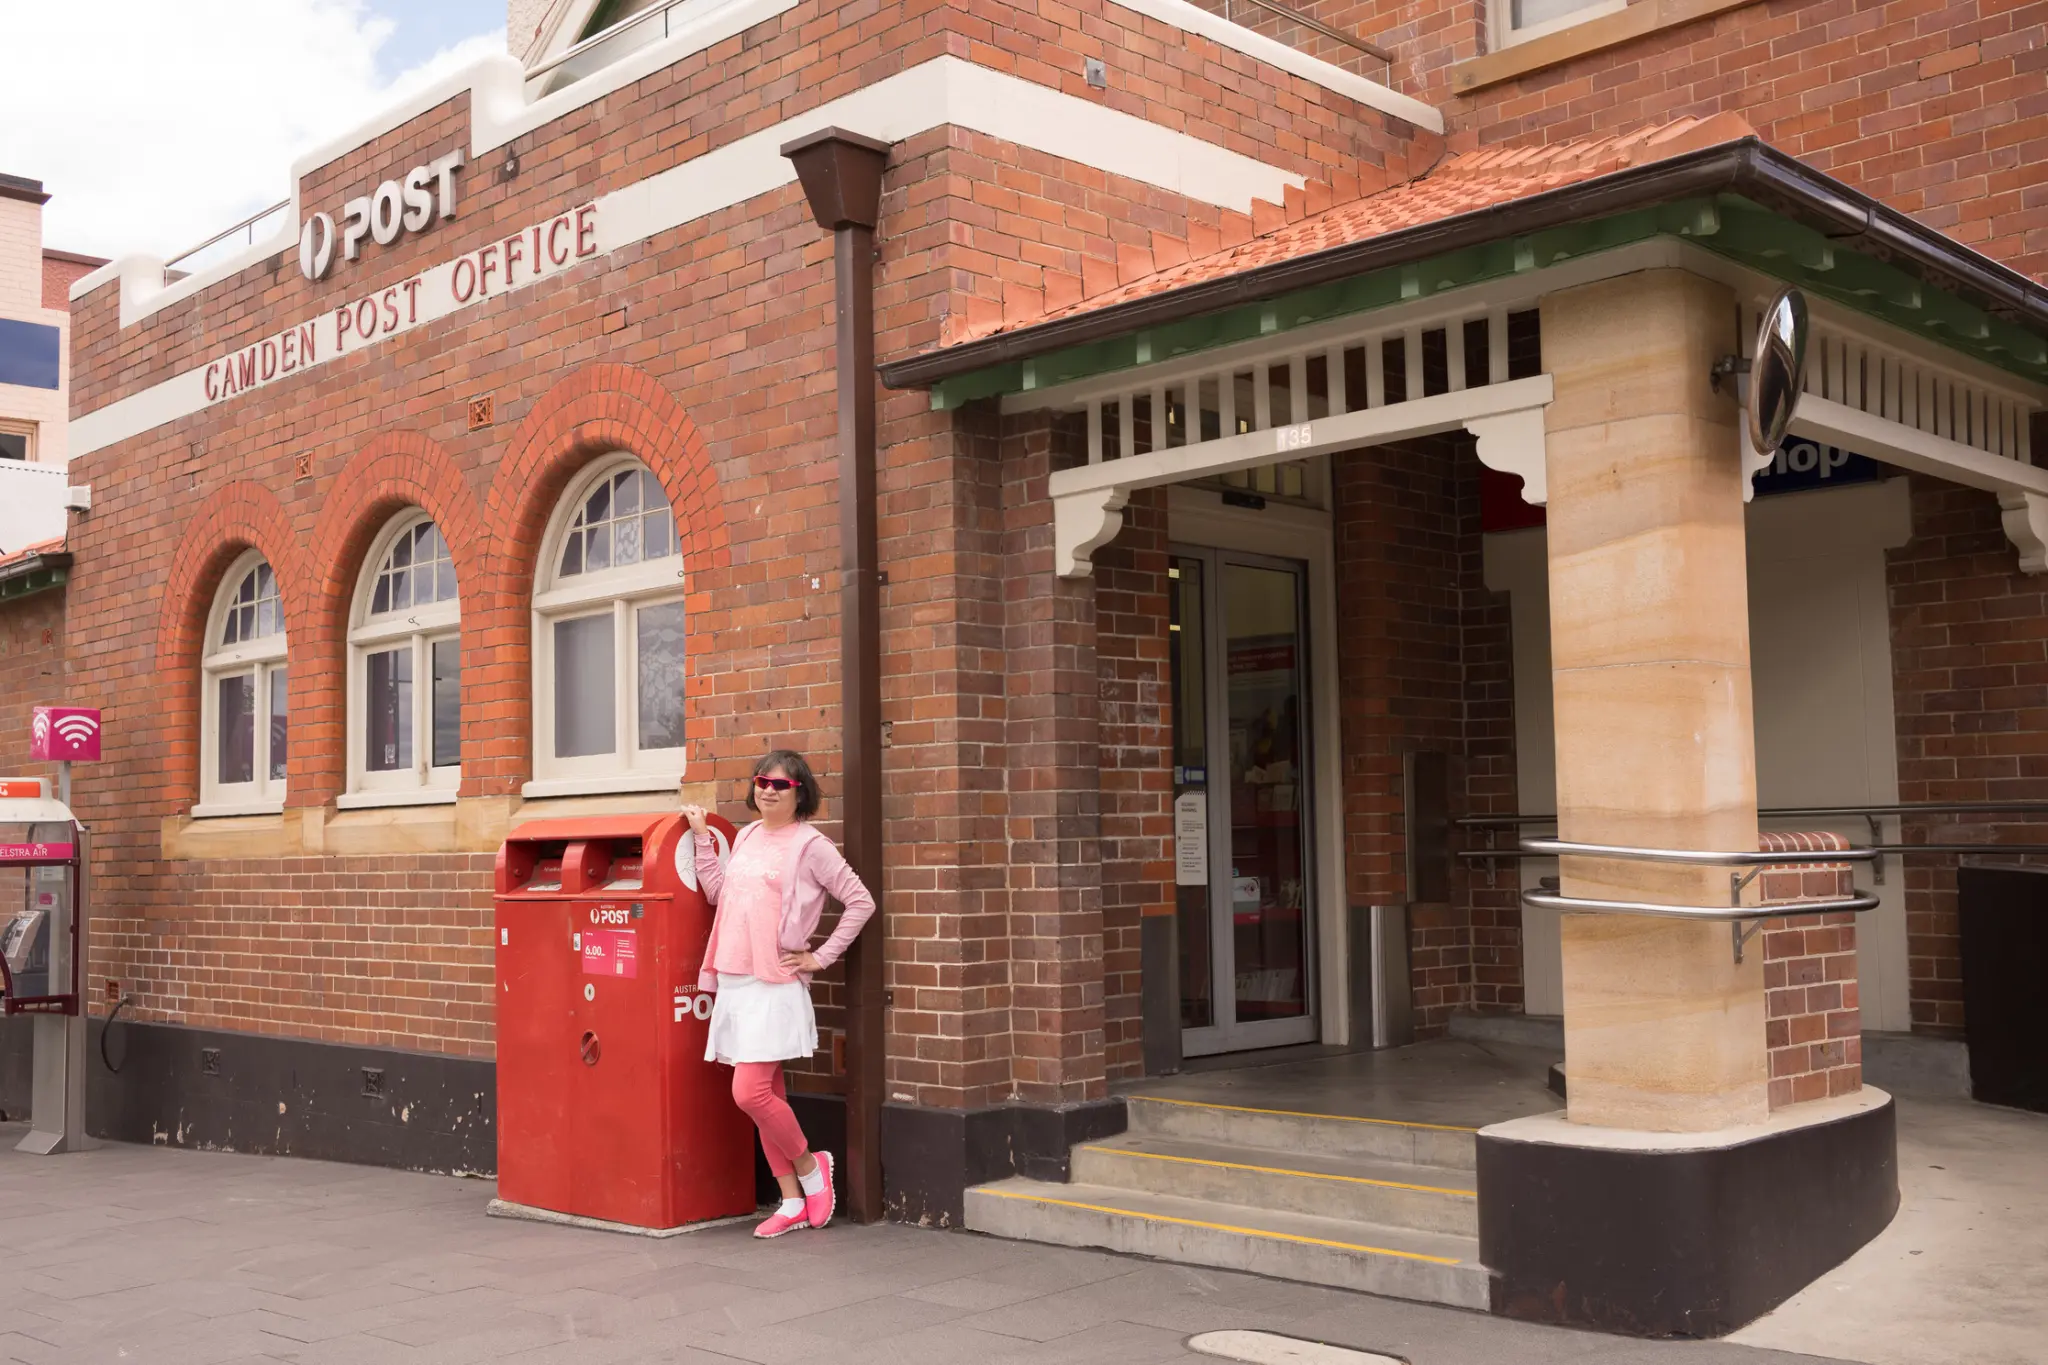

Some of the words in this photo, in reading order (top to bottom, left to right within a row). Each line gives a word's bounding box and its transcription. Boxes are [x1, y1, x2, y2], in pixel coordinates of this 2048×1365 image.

[344, 148, 464, 261] POST
[204, 323, 315, 400] CAMDEN
[335, 278, 421, 350] POST
[451, 204, 596, 302] OFFICE
[1280, 427, 1311, 449] 135
[601, 910, 629, 924] POST
[674, 993, 713, 1022] PO
